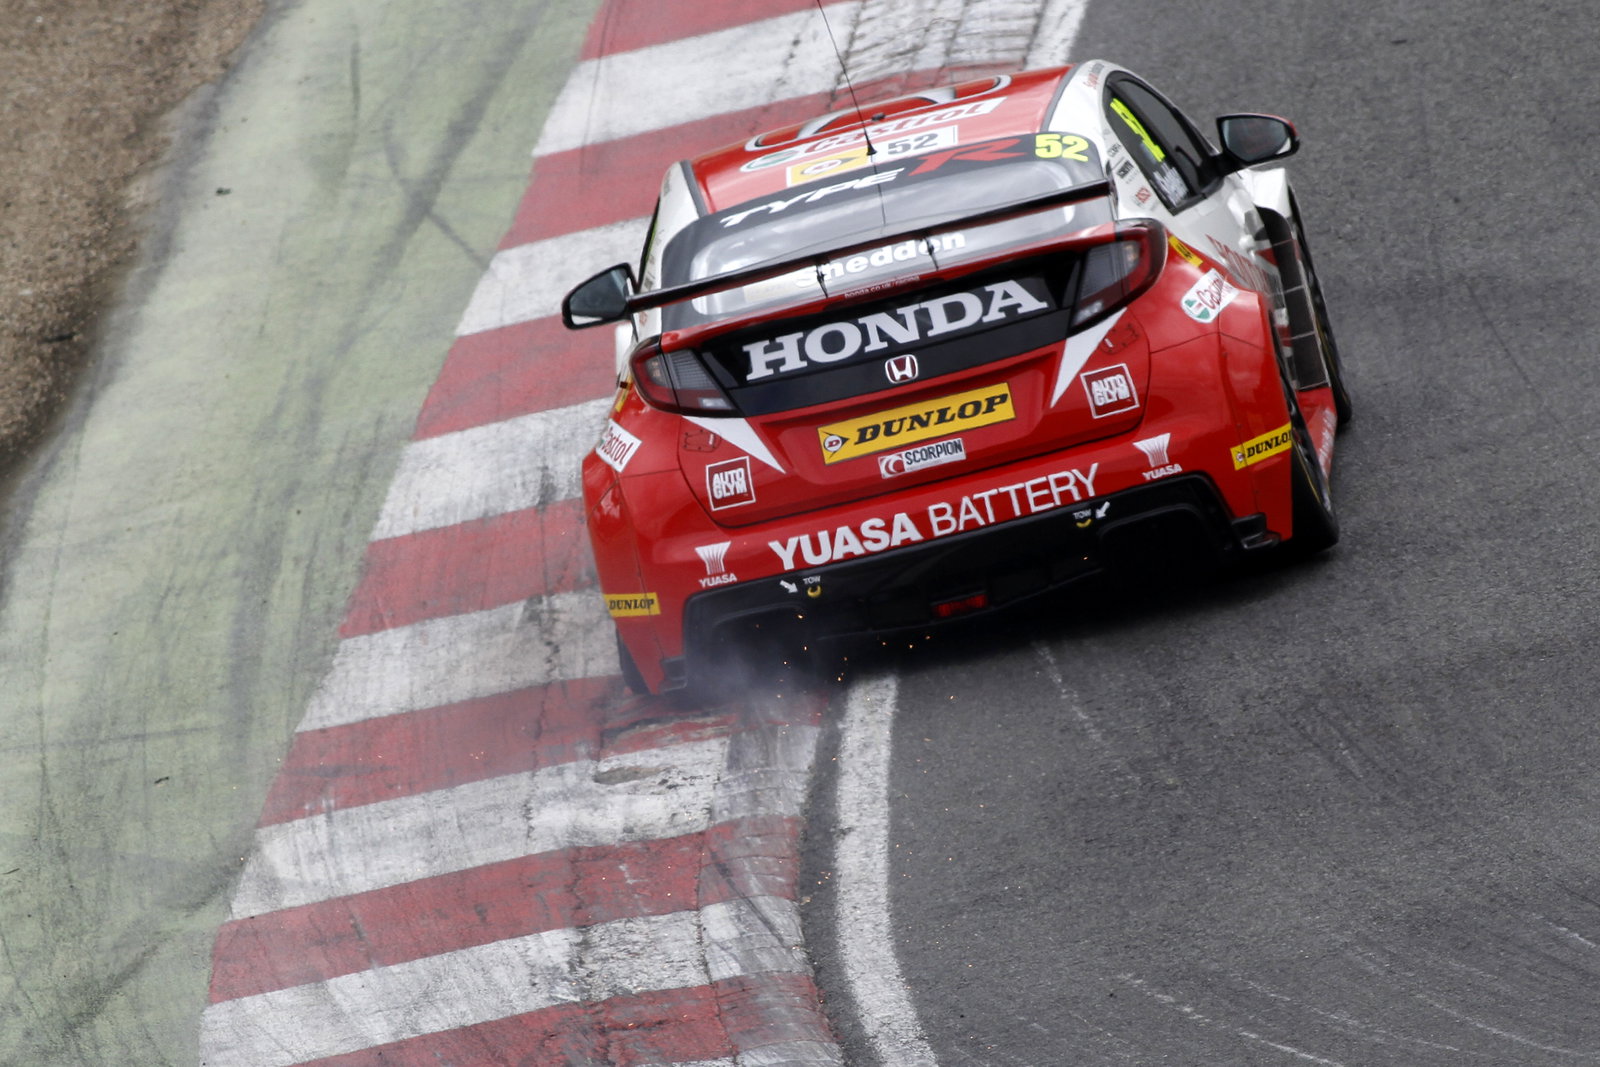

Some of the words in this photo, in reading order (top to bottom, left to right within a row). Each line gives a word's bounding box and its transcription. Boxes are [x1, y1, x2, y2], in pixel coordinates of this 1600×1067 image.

[804, 103, 986, 152] Castrol
[886, 132, 939, 156] 52
[1035, 133, 1089, 162] 52
[720, 168, 905, 228] TYPE
[908, 138, 1027, 177] R
[794, 232, 966, 288] Sneddon
[742, 279, 1048, 381] HONDA
[853, 392, 1009, 446] DUNLOP
[904, 439, 963, 465] SCORPION
[1247, 429, 1292, 457] DUNLO
[713, 467, 746, 485] AUTO
[1142, 463, 1183, 481] YUASA
[713, 480, 747, 499] GLYM
[768, 512, 924, 571] YUASA
[928, 462, 1099, 537] BATTERY
[1073, 508, 1092, 520] TOW
[698, 572, 737, 588] YUASA
[802, 575, 821, 585] TOW
[608, 598, 655, 611] DUNLOP
